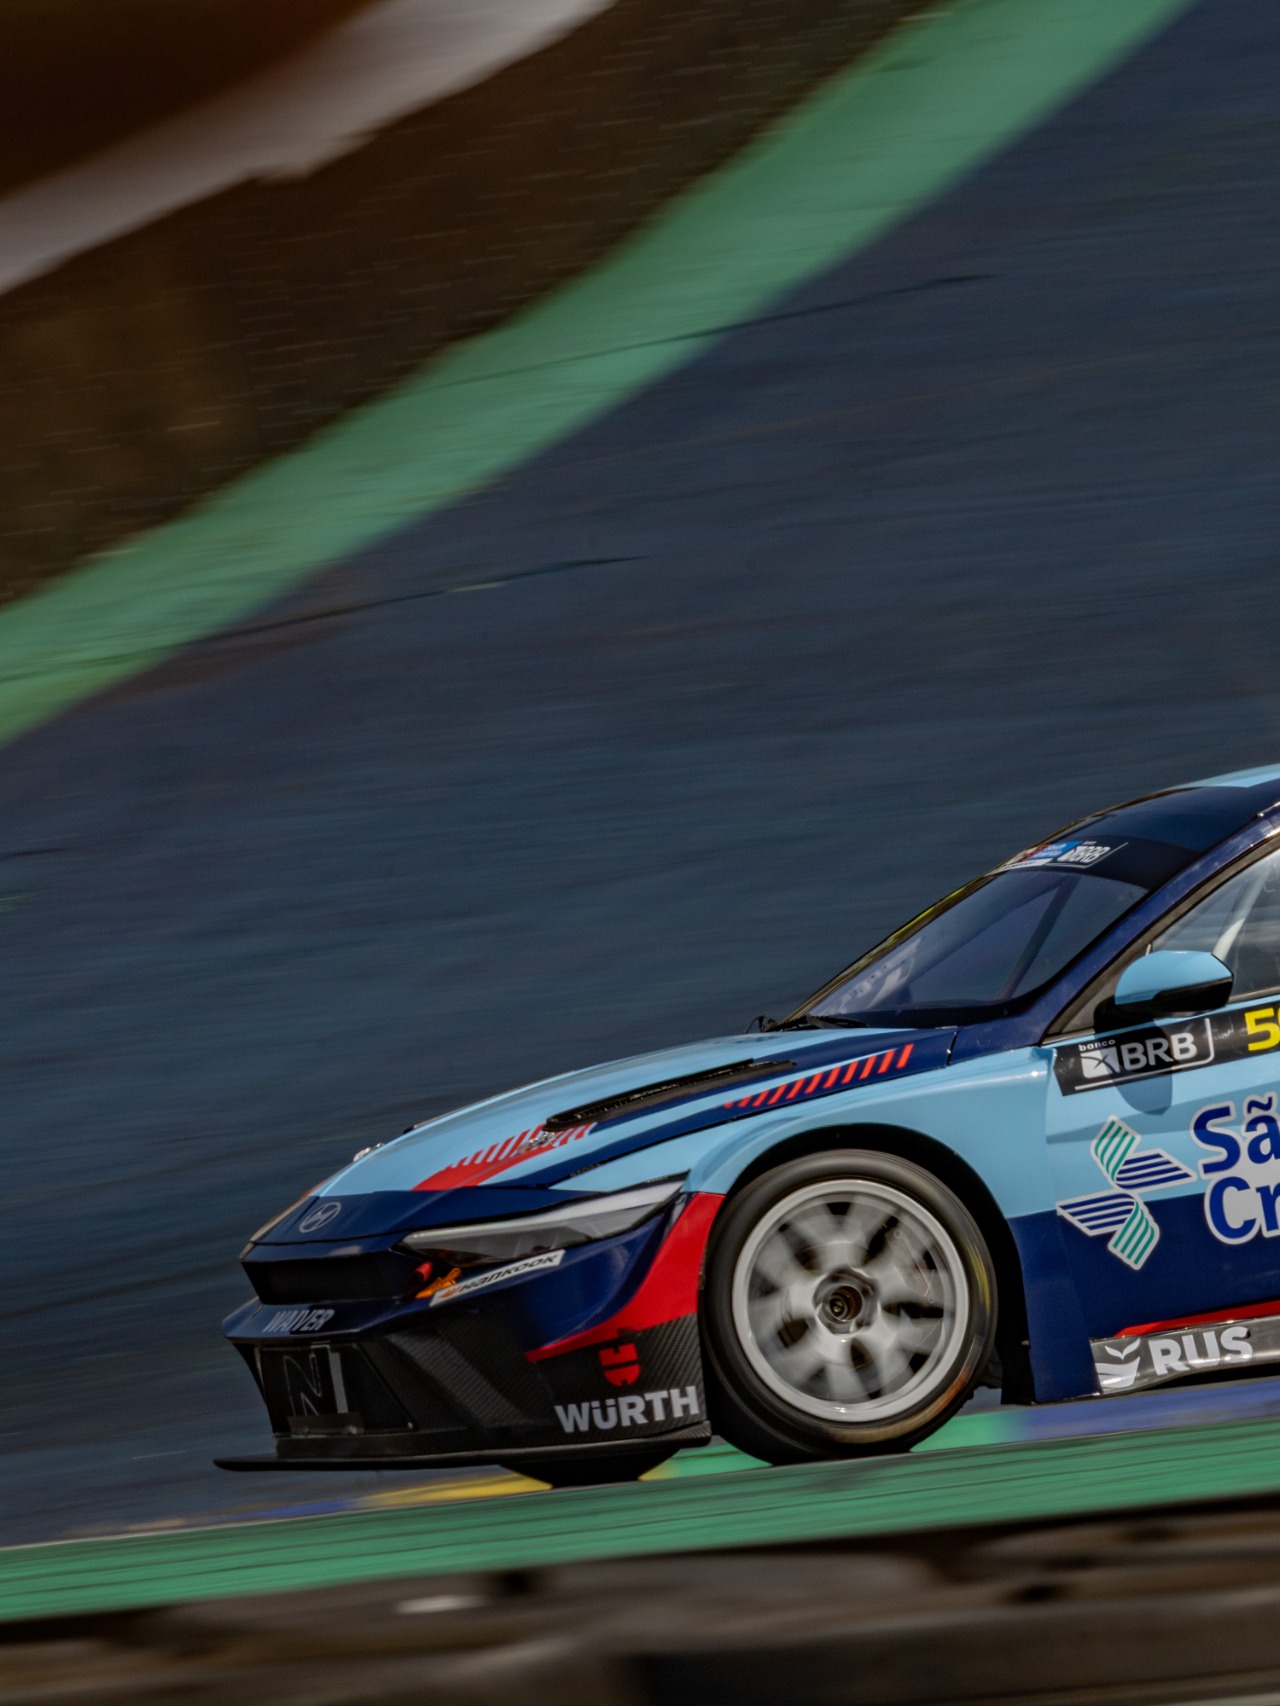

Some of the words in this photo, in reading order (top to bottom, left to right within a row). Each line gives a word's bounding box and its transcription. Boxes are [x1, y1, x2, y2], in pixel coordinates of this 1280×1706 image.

[1078, 1039, 1116, 1052] banco
[1120, 1032, 1199, 1073] BRB
[1148, 1326, 1253, 1376] RUS
